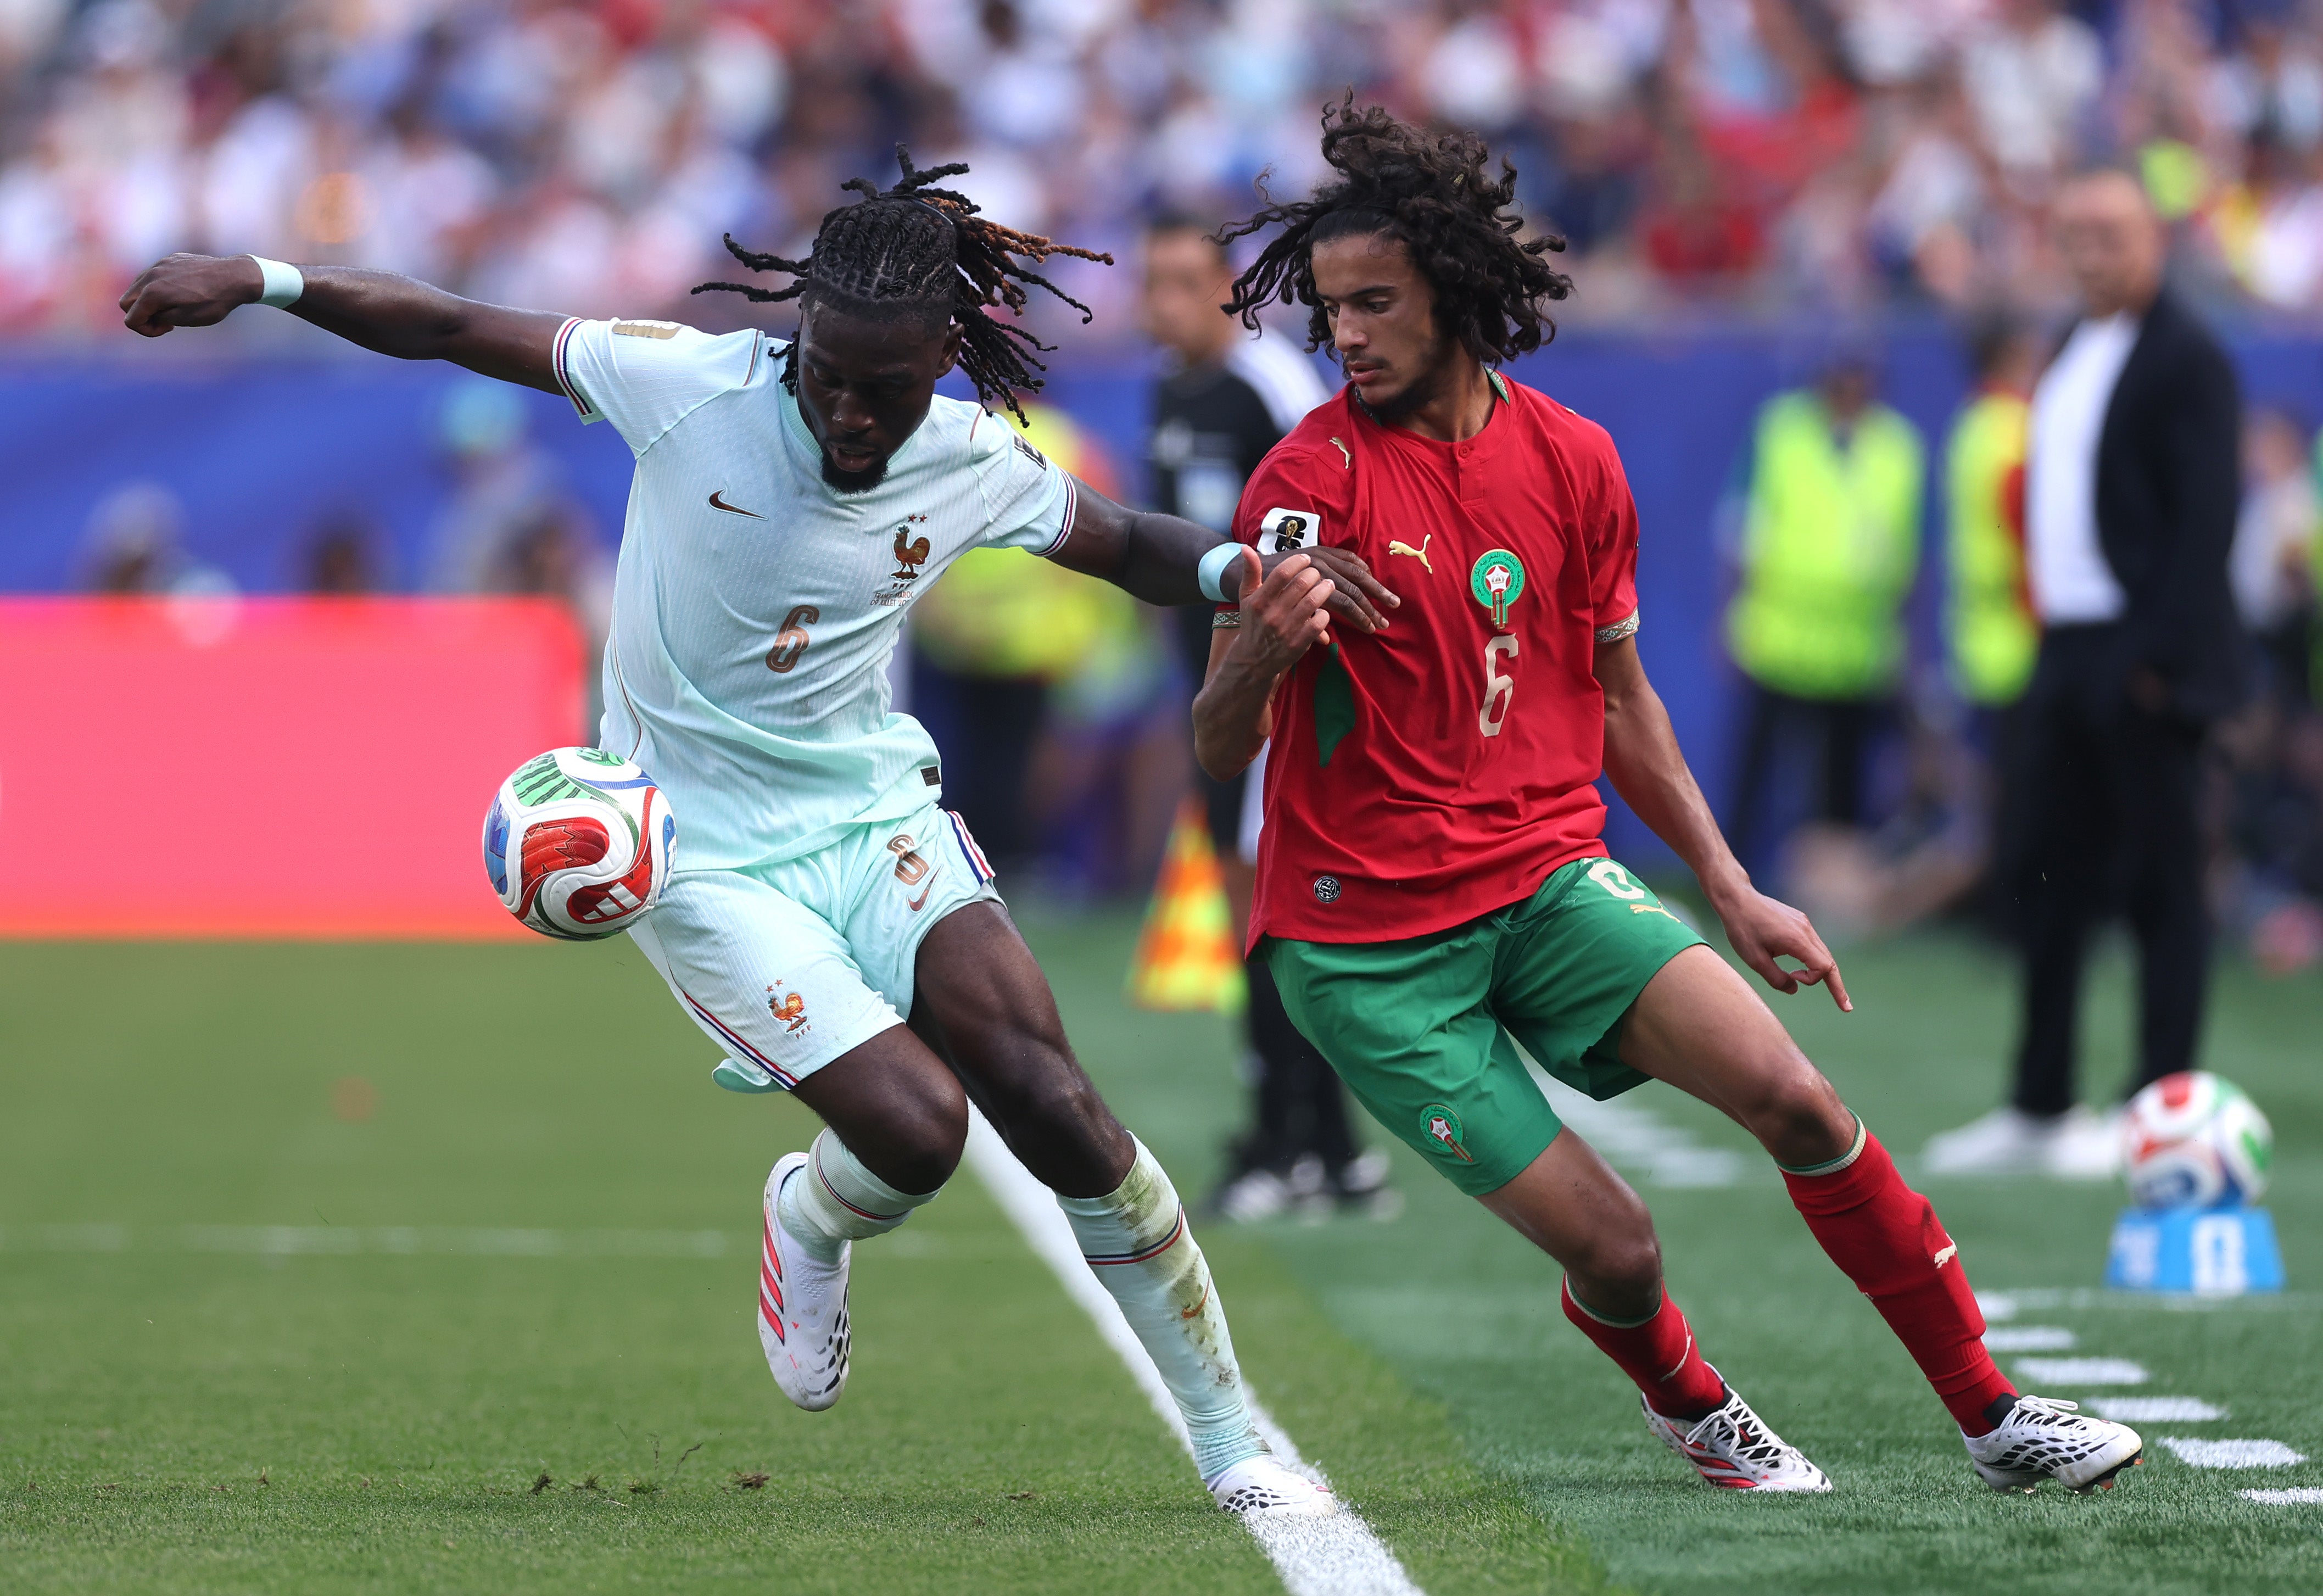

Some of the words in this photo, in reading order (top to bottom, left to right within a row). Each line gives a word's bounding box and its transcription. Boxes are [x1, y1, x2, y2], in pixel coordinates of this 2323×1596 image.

[765, 605, 820, 673] 6
[1479, 633, 1519, 738] 6
[886, 834, 930, 886] 6
